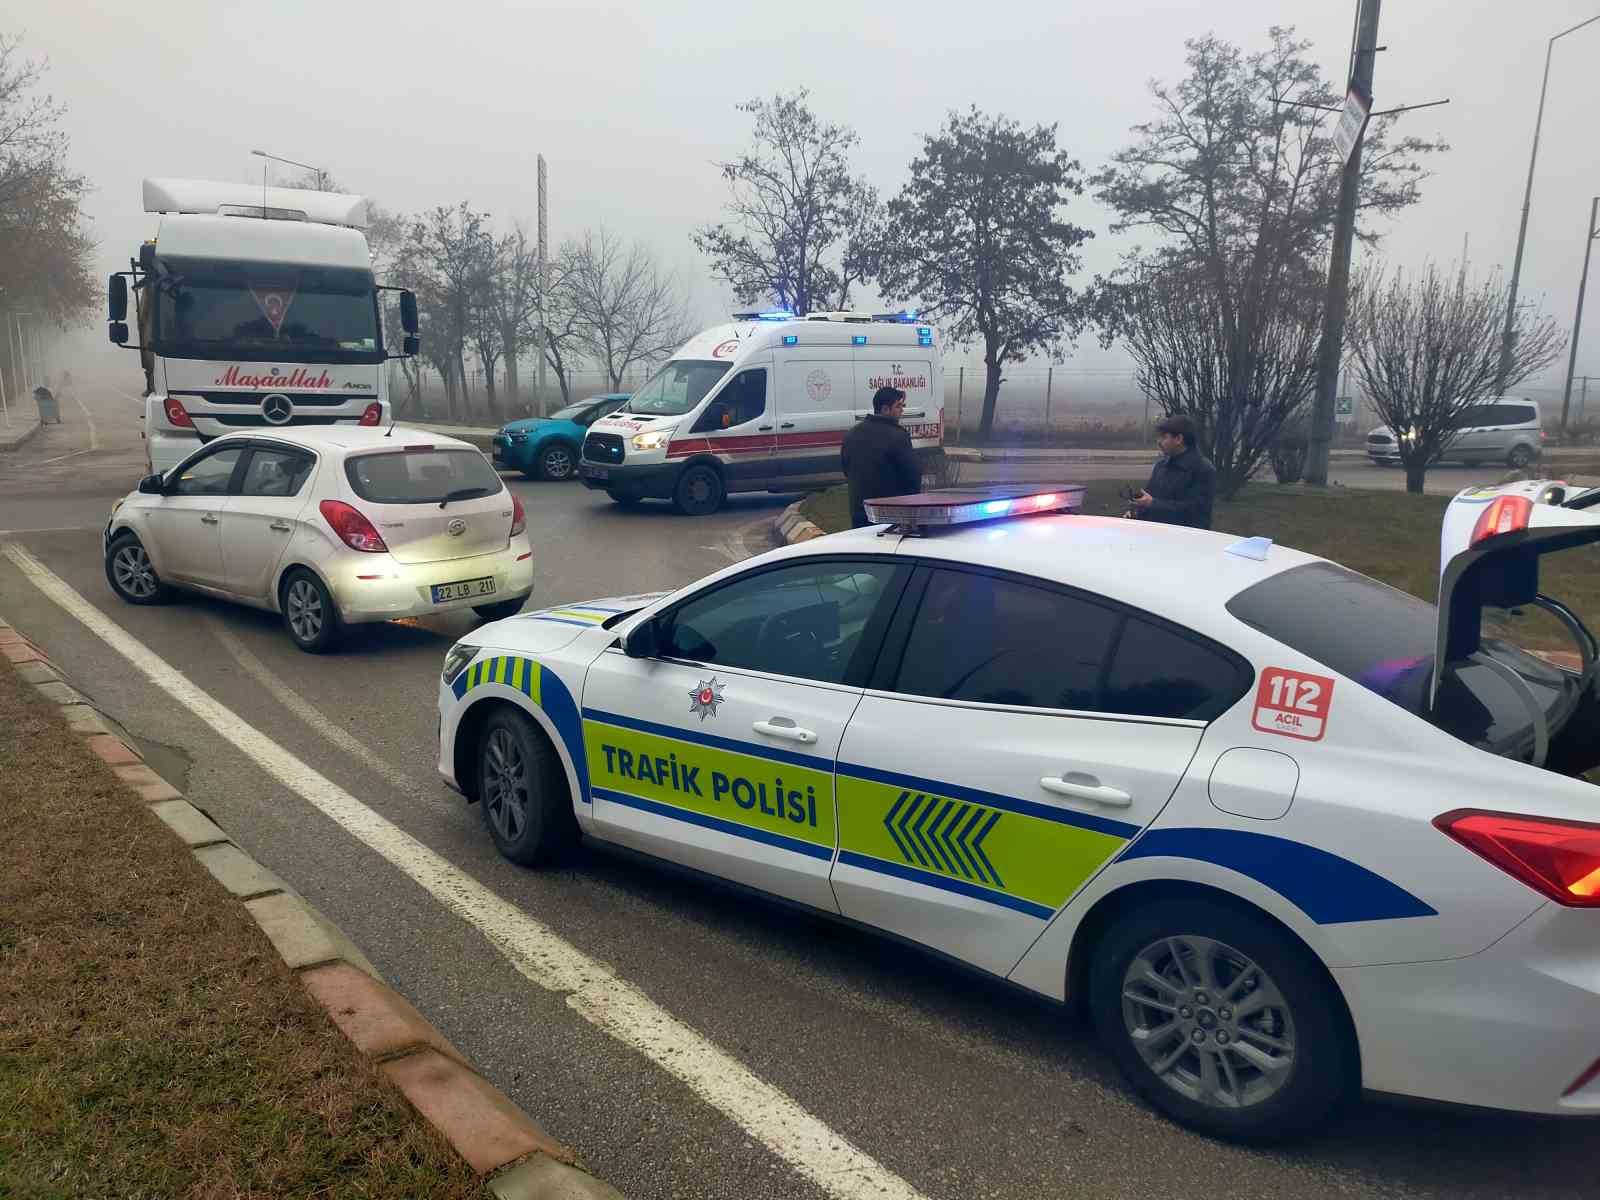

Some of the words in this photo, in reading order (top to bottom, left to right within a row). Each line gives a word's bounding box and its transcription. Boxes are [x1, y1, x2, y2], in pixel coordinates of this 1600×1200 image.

[214, 365, 334, 390] Maşaallah
[868, 375, 891, 389] SAĞLIK
[893, 374, 926, 389] BAKANLIĞI
[439, 587, 452, 600] 22
[479, 579, 494, 593] 211
[1270, 675, 1321, 712] 112
[601, 743, 703, 798] TRAFİK
[711, 770, 817, 828] POLİSİ
